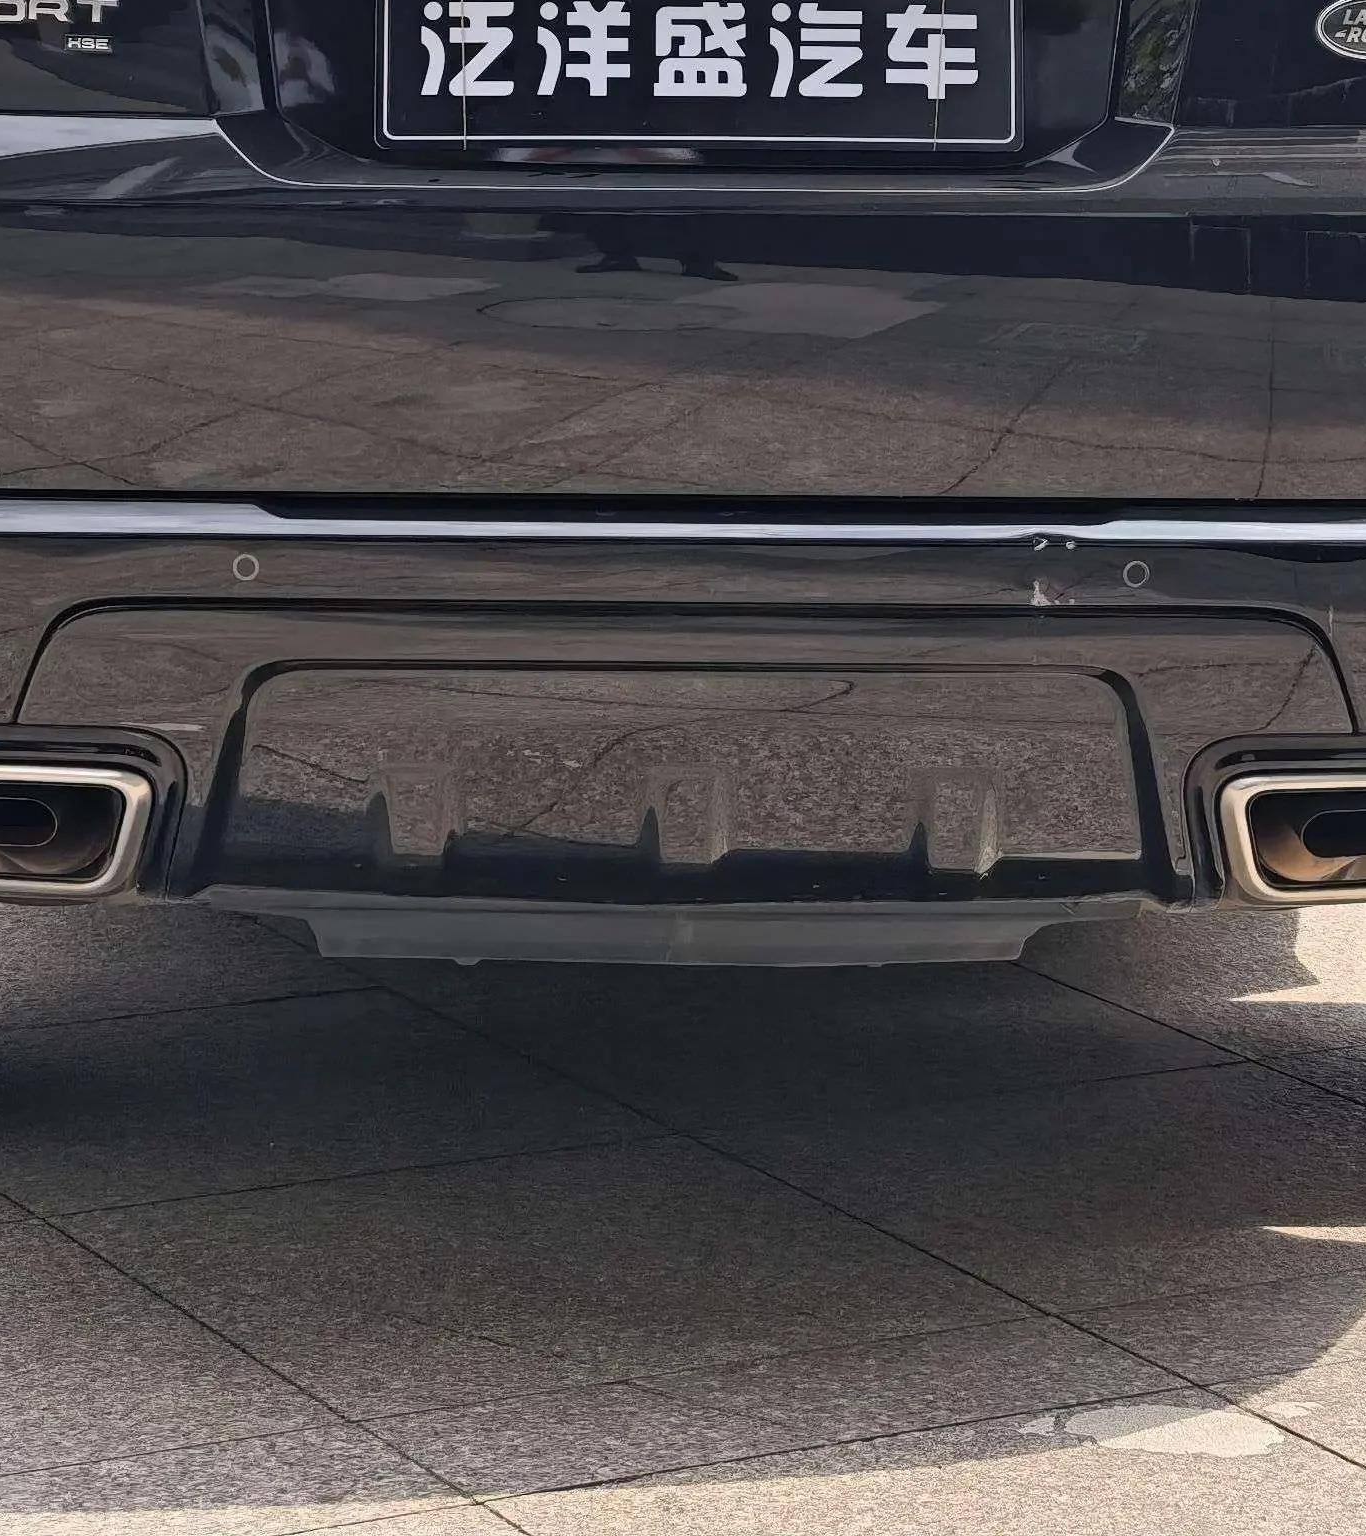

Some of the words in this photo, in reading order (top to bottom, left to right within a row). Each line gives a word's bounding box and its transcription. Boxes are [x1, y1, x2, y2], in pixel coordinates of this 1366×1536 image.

[67, 36, 110, 51] HSE
[420, 0, 979, 100] 泛洋盛汽车
